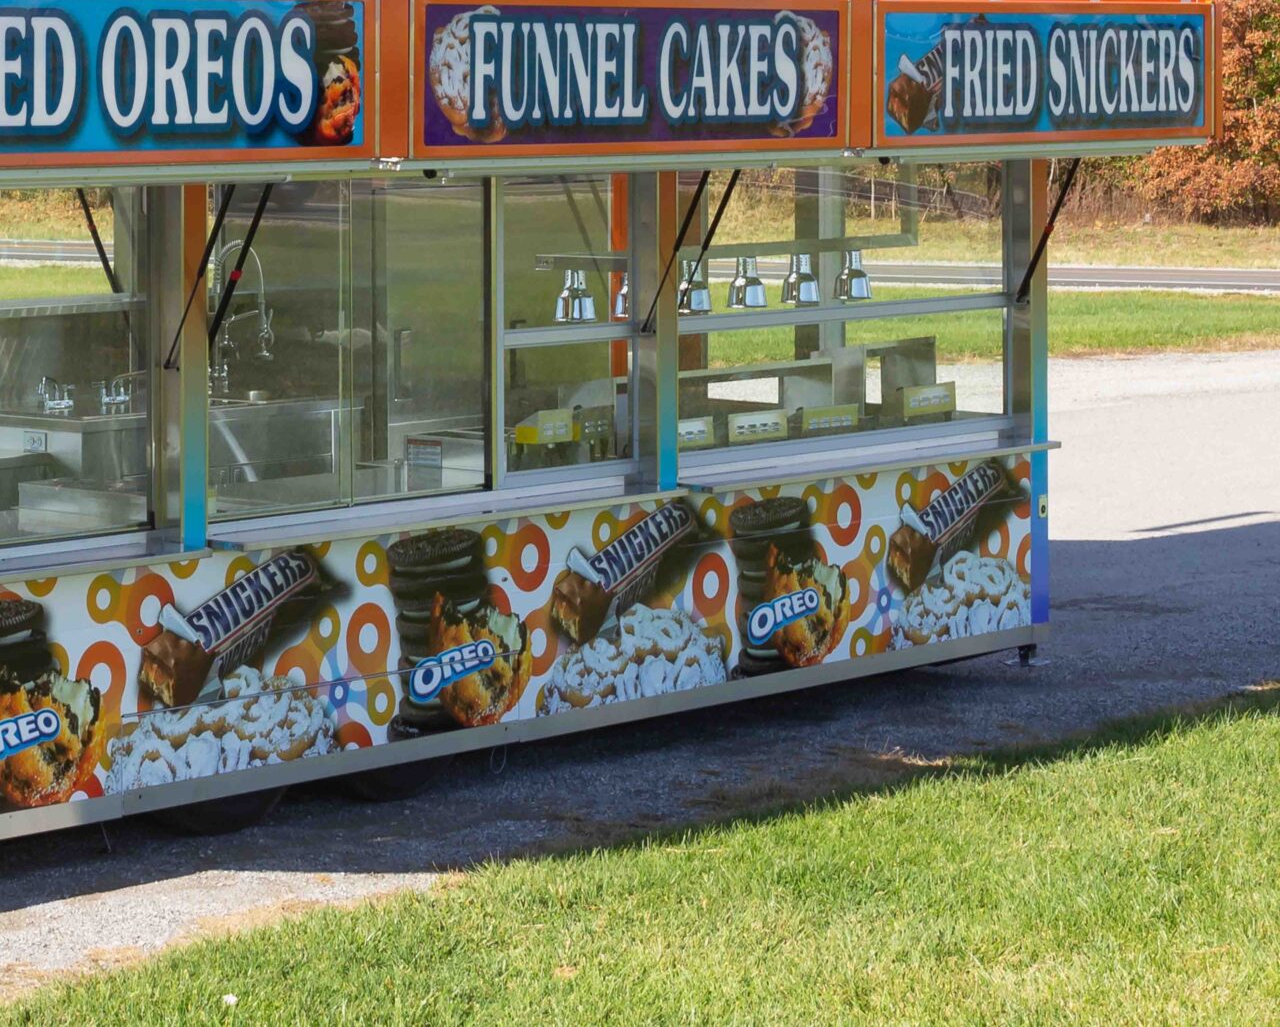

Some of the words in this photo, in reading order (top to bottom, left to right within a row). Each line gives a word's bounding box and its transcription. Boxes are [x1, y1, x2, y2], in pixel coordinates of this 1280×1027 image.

[101, 17, 312, 127] OREOS
[470, 22, 645, 121] FUNNEL
[659, 21, 798, 119] CAKES
[944, 29, 1037, 117] FRIED
[1048, 27, 1195, 114] SNICKERS
[590, 503, 690, 590] SNICKERS
[919, 463, 1001, 542] SNICKERS
[186, 553, 311, 649] SNICKERS
[750, 590, 818, 639] OREO
[414, 642, 494, 696] OREO
